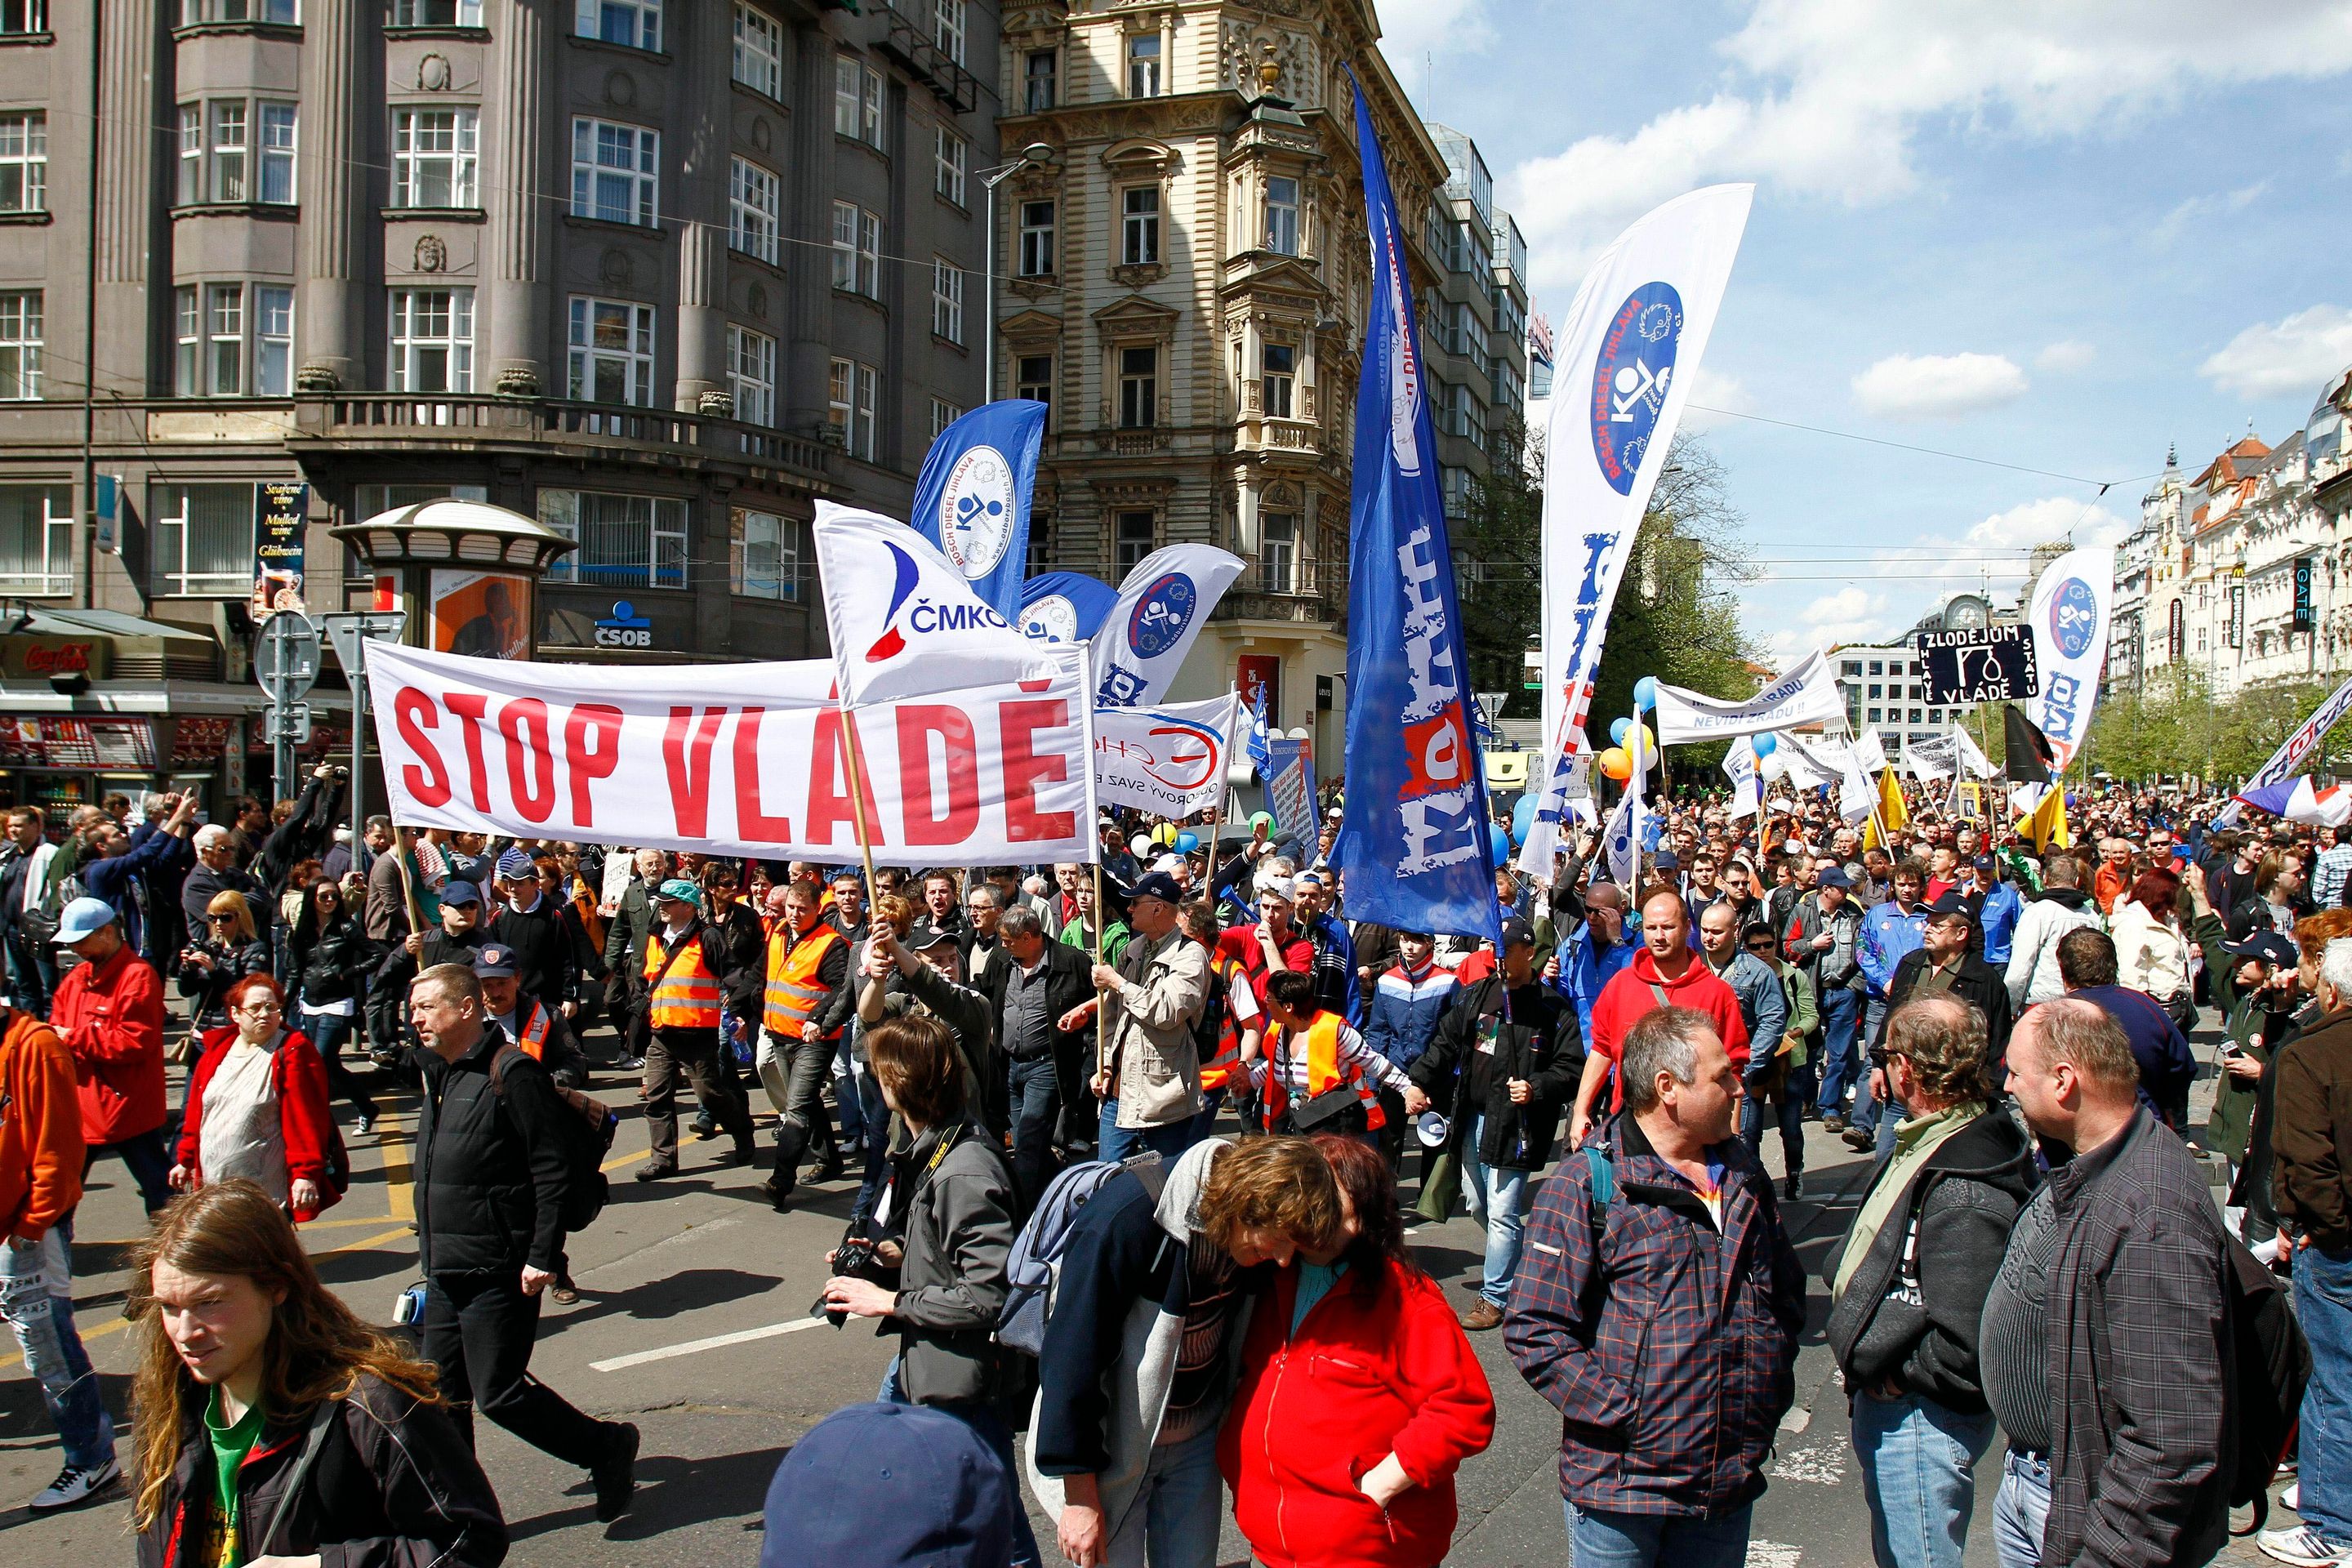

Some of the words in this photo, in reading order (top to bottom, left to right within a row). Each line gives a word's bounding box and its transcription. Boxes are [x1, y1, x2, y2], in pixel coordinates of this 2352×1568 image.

[1605, 299, 1643, 360] JIHLAVA
[1595, 365, 1613, 421] DIESEL
[1597, 426, 1621, 479] BOSCH
[952, 457, 975, 492] JIHLAVA
[265, 513, 301, 525] Mulled
[944, 494, 956, 529] DIESEL
[991, 469, 1013, 560] www.odborybosch.cz
[271, 524, 293, 535] wine
[258, 544, 303, 556] Glühwein
[946, 532, 964, 566] BOSCH
[1031, 599, 1055, 616] JIHLAVA
[2296, 568, 2308, 620] GATE
[911, 598, 1021, 634] ČMKO
[595, 627, 651, 646] ČSOB
[2023, 639, 2036, 695] STÁTU
[1943, 678, 2011, 704] VLÁDĚ
[1694, 711, 1744, 728] NEVIDÍ
[1747, 706, 1794, 724] ZRADU
[395, 685, 623, 828] STOP
[929, 1142, 948, 1169] Nikon
